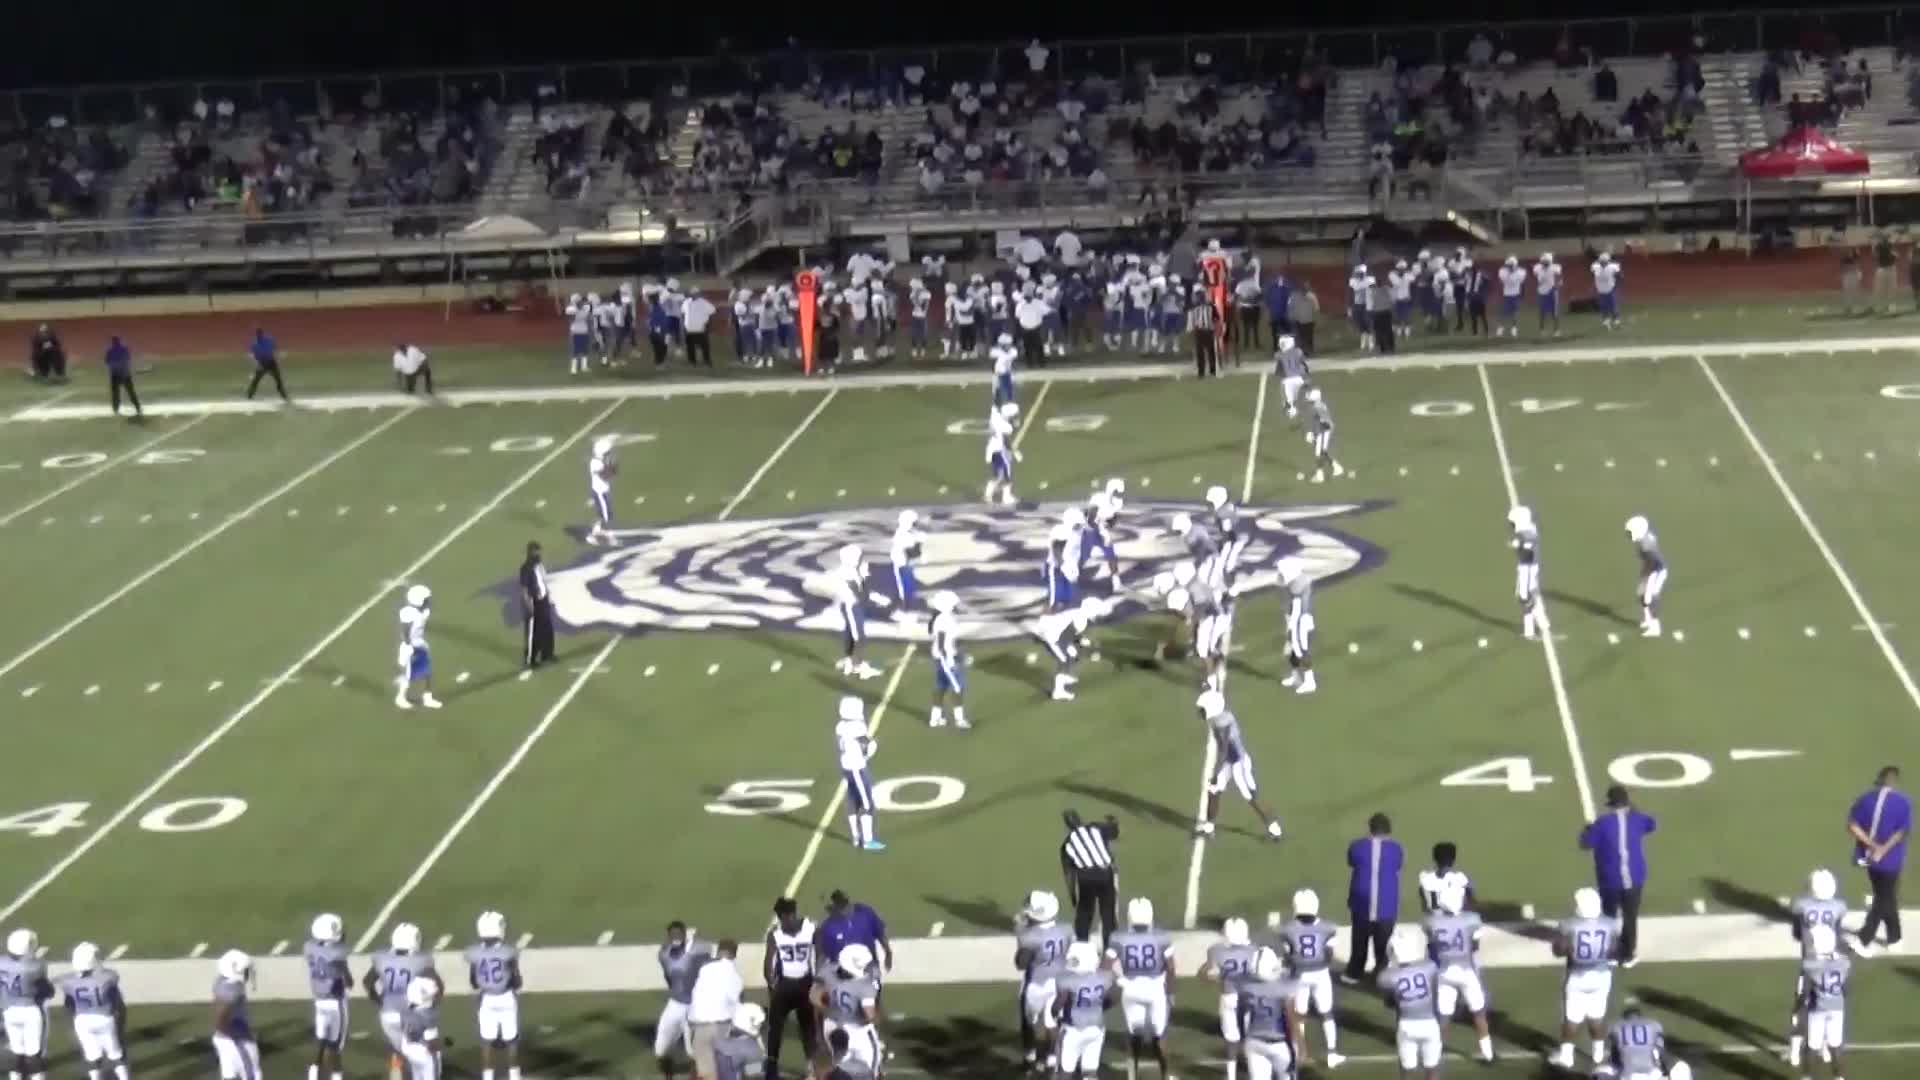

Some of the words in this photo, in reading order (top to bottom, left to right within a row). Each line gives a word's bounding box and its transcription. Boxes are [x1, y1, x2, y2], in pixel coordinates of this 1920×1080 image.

[1440, 753, 1712, 792] 40
[704, 774, 967, 813] 50
[0, 798, 248, 835] 40
[780, 943, 810, 962] 35
[1125, 944, 1157, 970] 68
[1299, 935, 1316, 960] 8
[1577, 930, 1607, 960] 67
[479, 958, 504, 984] 42
[1399, 972, 1429, 1001] 29
[1621, 1024, 1648, 1046] 10
